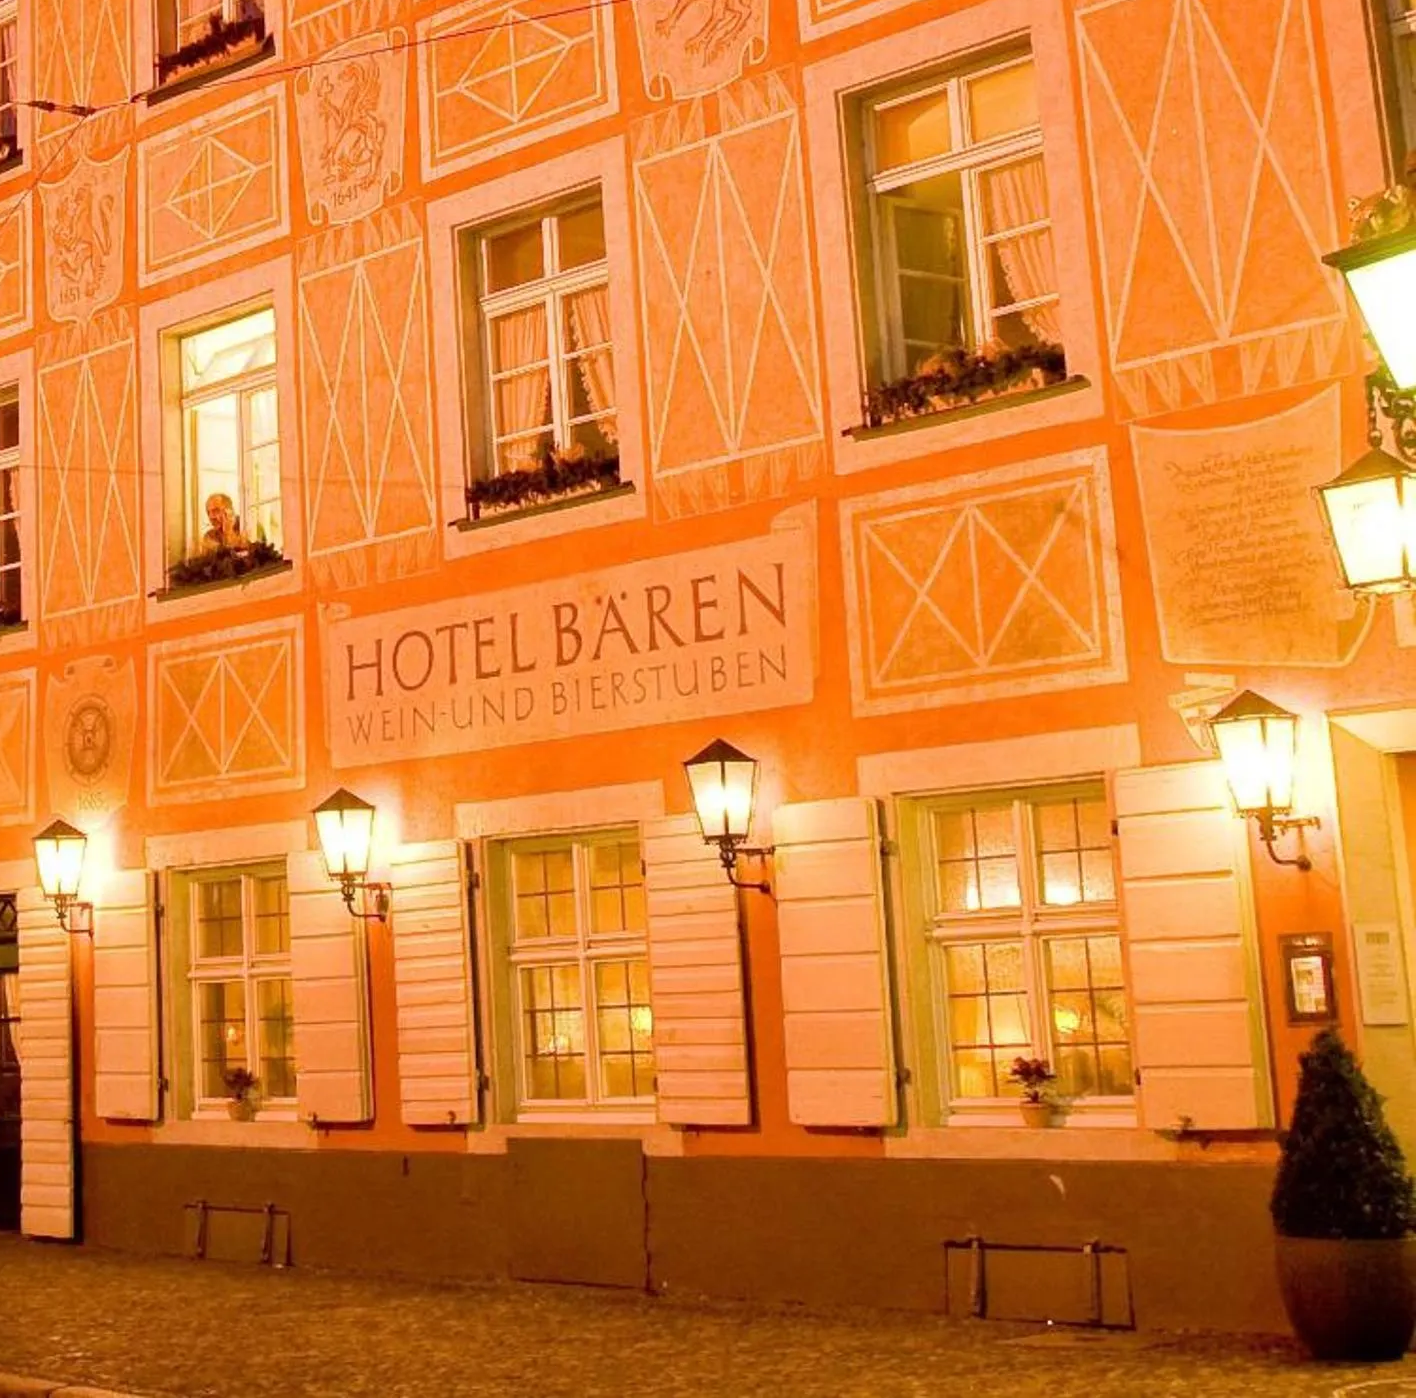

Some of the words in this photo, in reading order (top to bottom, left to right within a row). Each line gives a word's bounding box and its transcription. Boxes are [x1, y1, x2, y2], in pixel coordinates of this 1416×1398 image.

[345, 611, 537, 701] HOTEL
[552, 562, 788, 667] BÄREN
[551, 643, 789, 717] BIERSTUBEN
